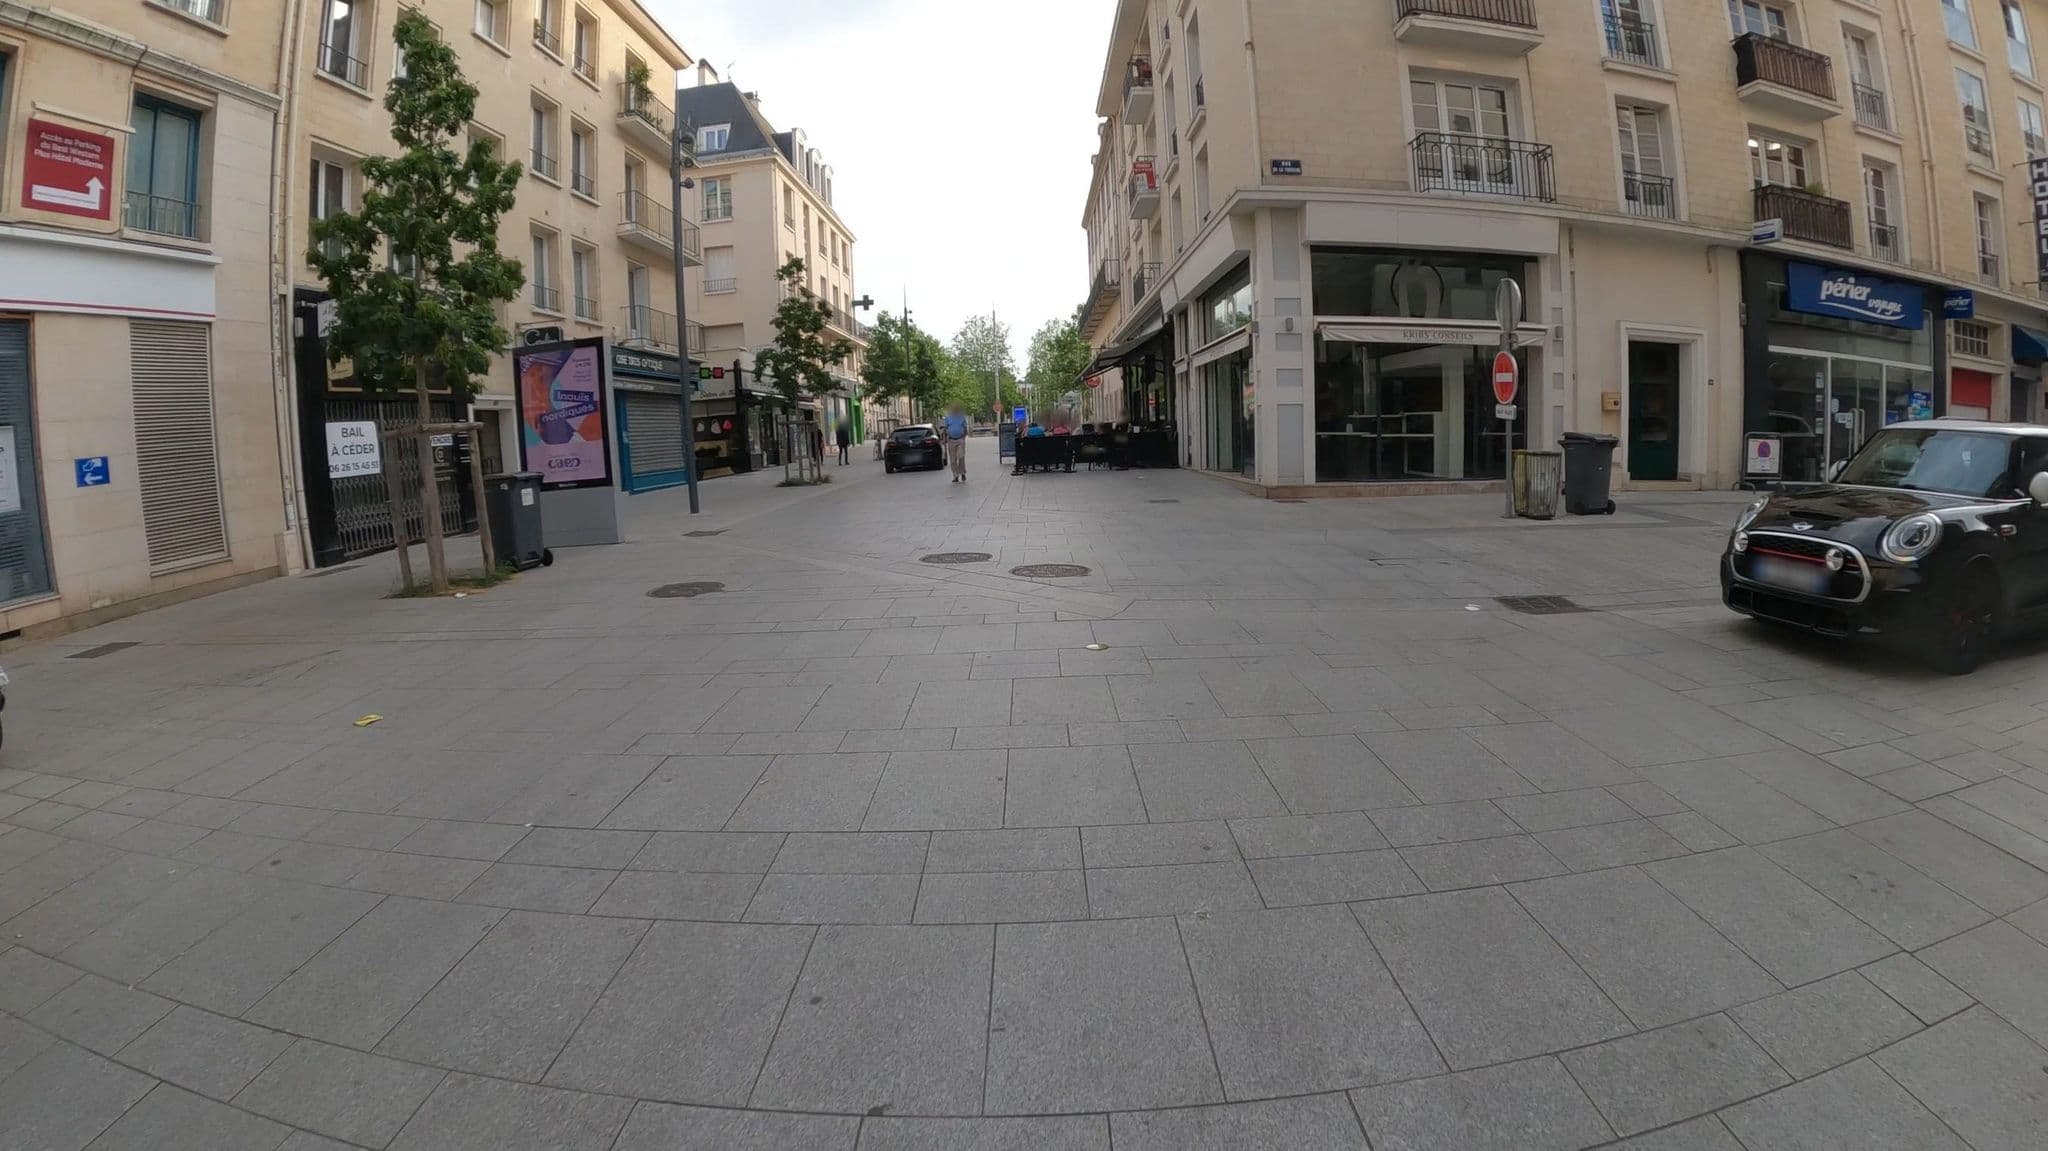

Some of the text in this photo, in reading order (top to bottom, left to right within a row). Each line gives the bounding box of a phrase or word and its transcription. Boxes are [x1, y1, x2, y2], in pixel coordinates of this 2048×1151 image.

[40, 132, 63, 143] Accès
[74, 139, 102, 153] Parking
[34, 148, 104, 169] Plus Hôtel Moderne
[52, 143, 68, 153] Best
[69, 147, 100, 160] Western
[1820, 277, 1871, 301] périer
[1868, 298, 1903, 315] voyages
[341, 427, 365, 438] BAIL
[331, 443, 375, 456] À CÉDER
